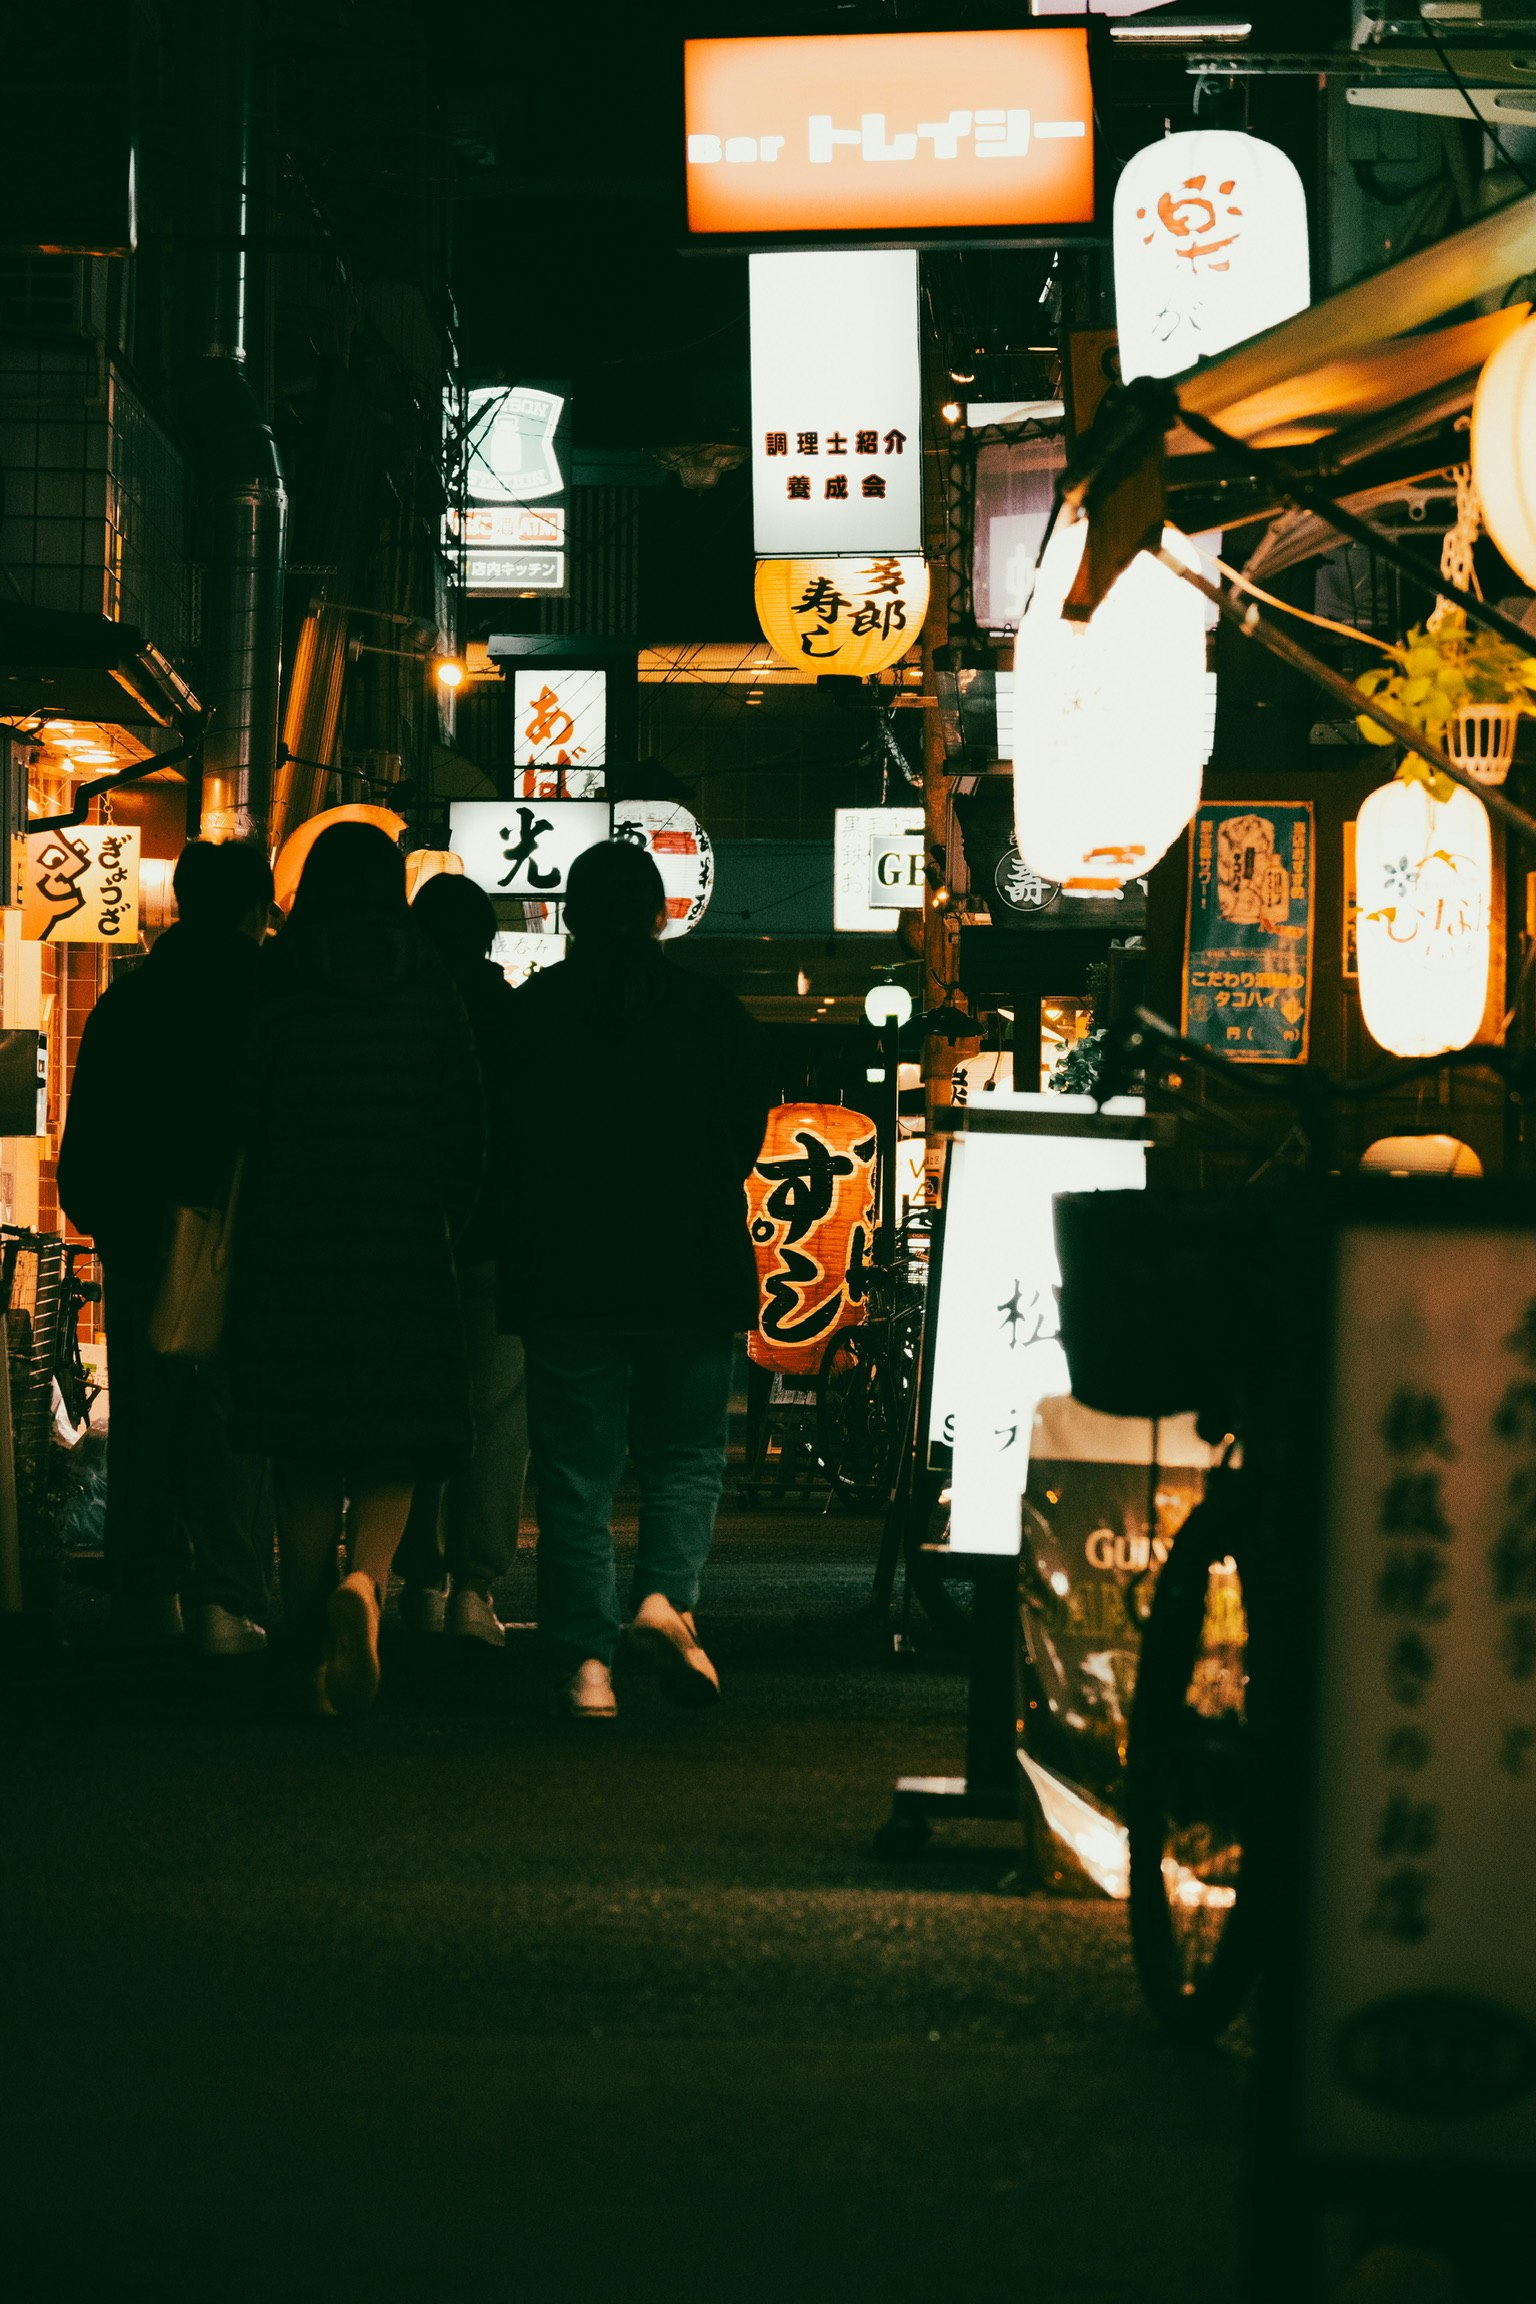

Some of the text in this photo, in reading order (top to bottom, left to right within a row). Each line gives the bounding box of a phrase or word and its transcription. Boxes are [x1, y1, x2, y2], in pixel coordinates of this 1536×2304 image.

[687, 133, 785, 164] Bar
[764, 428, 907, 457] 調理士紹介
[786, 474, 887, 501] 養成会
[471, 561, 555, 577] 店内キッチン
[497, 807, 562, 889] 光
[98, 834, 132, 936] ぎょうざ
[1215, 991, 1279, 1009] タコハイ
